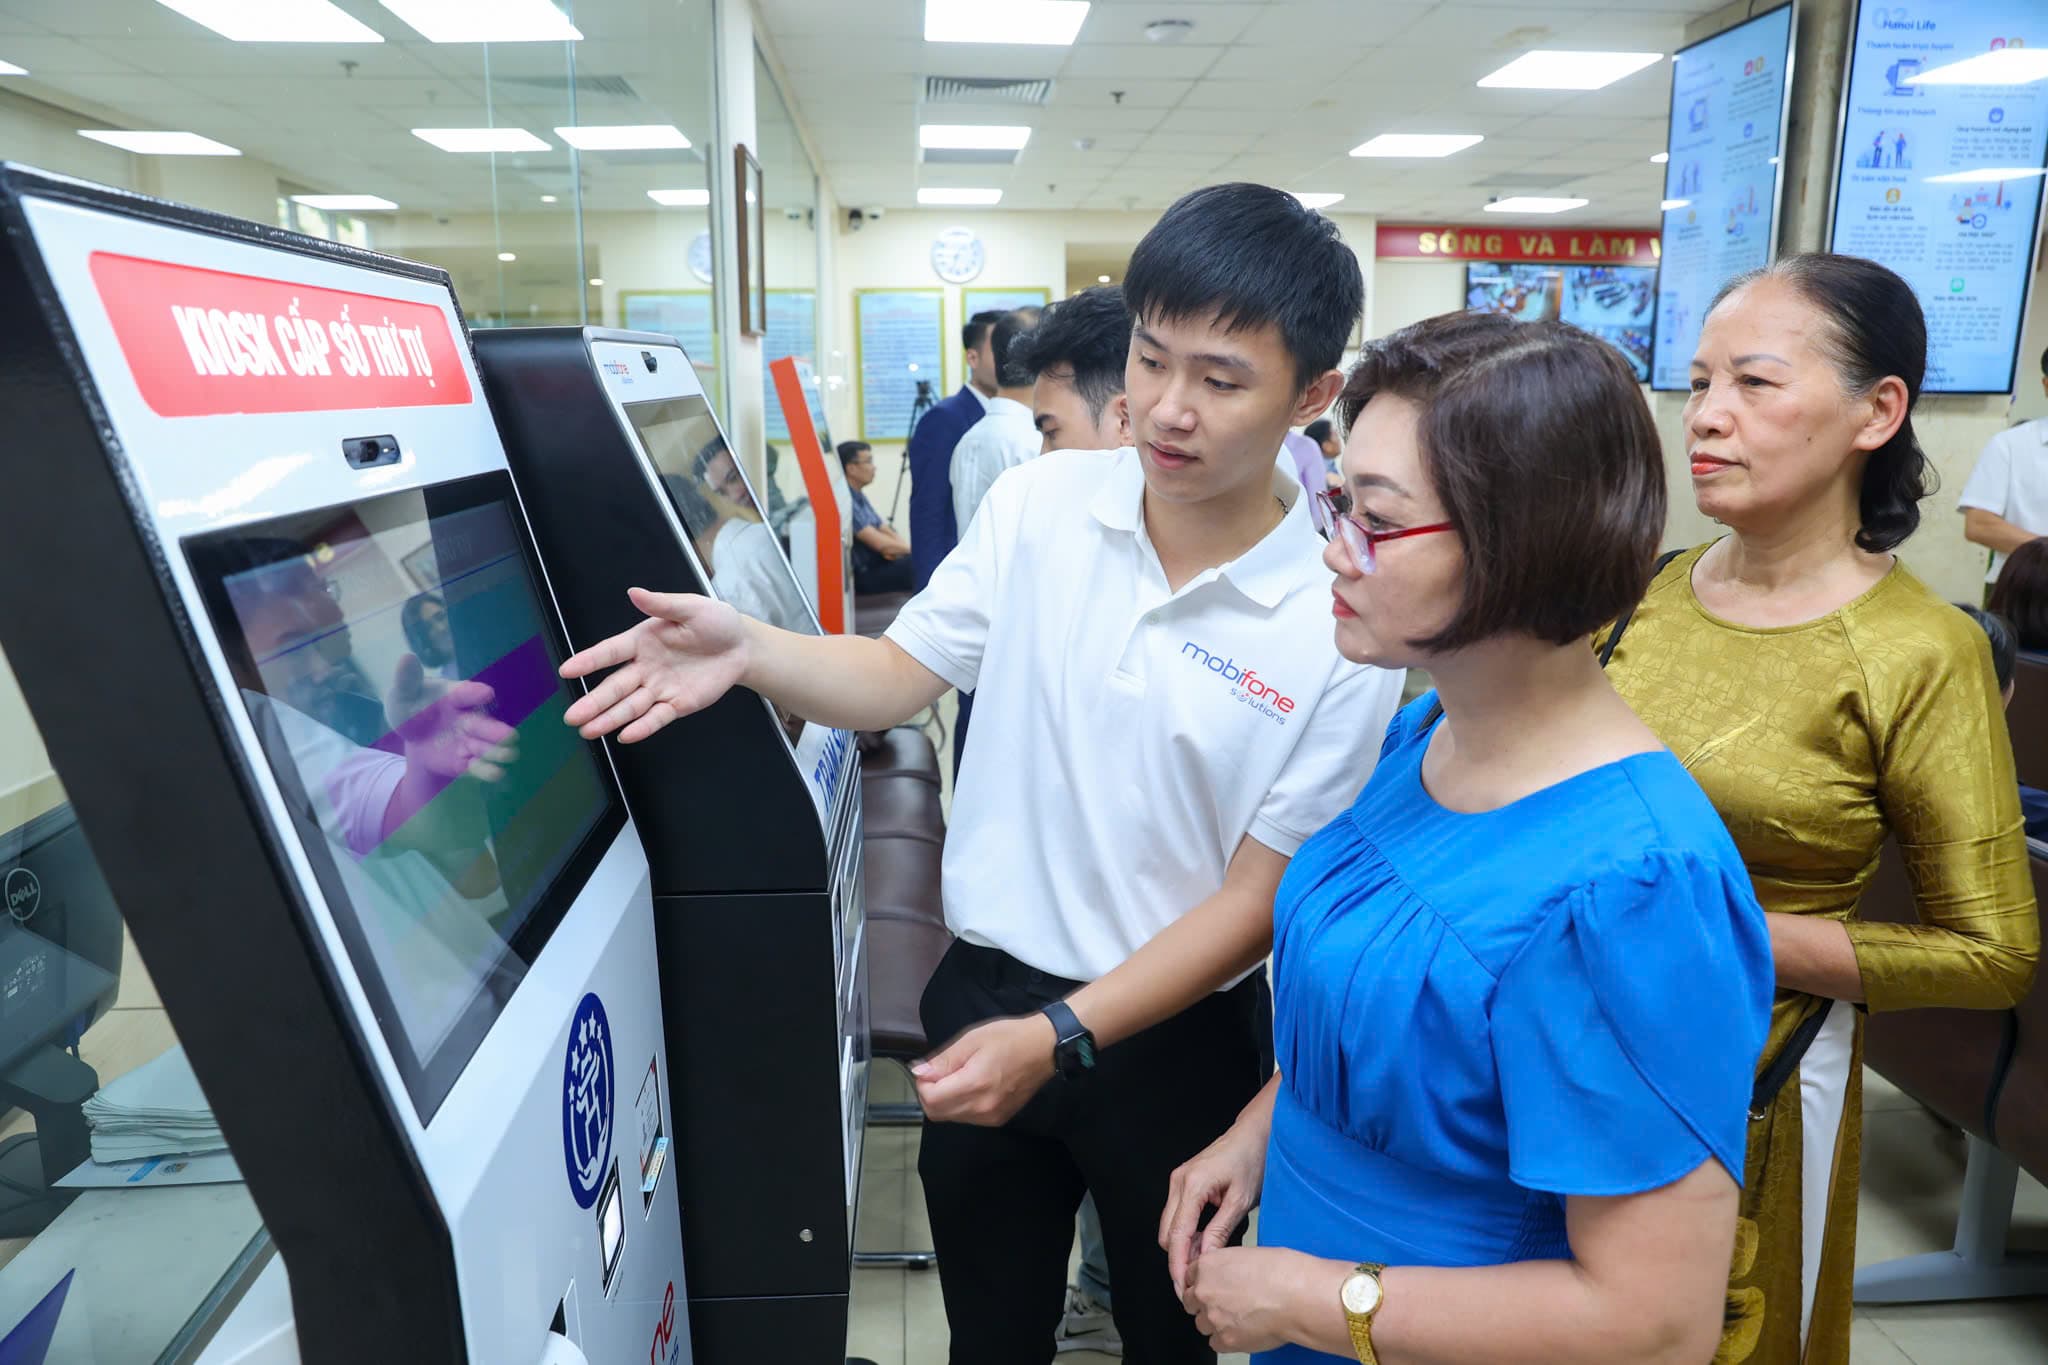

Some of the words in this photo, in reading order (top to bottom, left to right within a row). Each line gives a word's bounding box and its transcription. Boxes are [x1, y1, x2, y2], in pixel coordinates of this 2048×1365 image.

[1882, 20, 1914, 31] Hanoi
[1916, 19, 1936, 31] Life
[1418, 229, 1504, 255] SỐNG
[1519, 234, 1555, 256] VÀ
[1570, 235, 1636, 257] LÀM
[171, 304, 286, 376] KIOSK
[274, 297, 332, 377] CẤP
[329, 304, 372, 377] SỐ
[359, 315, 410, 377] THỨ
[399, 323, 436, 388] TỰ
[1181, 641, 1296, 714] mobifone
[1230, 687, 1287, 725] solutions
[9, 882, 38, 907] DELL
